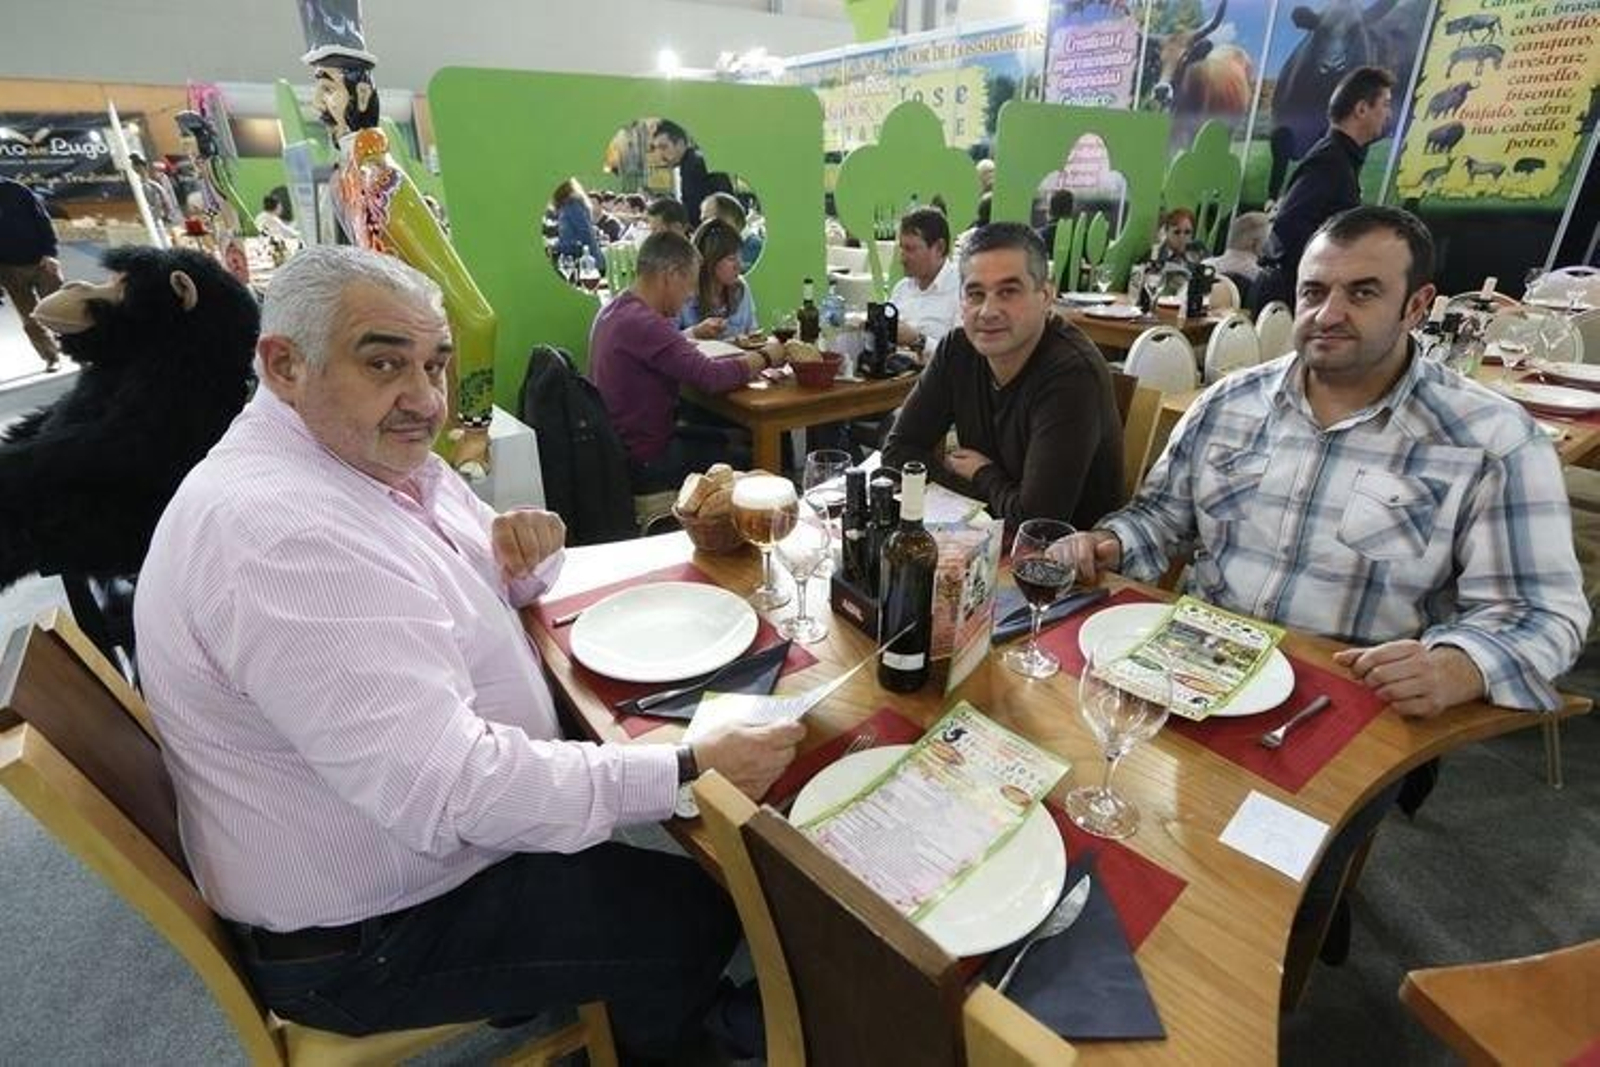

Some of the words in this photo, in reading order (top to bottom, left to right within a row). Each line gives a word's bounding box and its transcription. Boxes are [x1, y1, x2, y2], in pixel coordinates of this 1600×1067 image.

[1510, 14, 1600, 36] cocodrilo,
[1513, 36, 1594, 53] canguro,
[1507, 53, 1587, 70] avestruz,
[1507, 67, 1582, 85] camello,
[1505, 87, 1577, 100] bisonte,
[1501, 119, 1566, 133] caballo
[49, 138, 109, 160] Lugo
